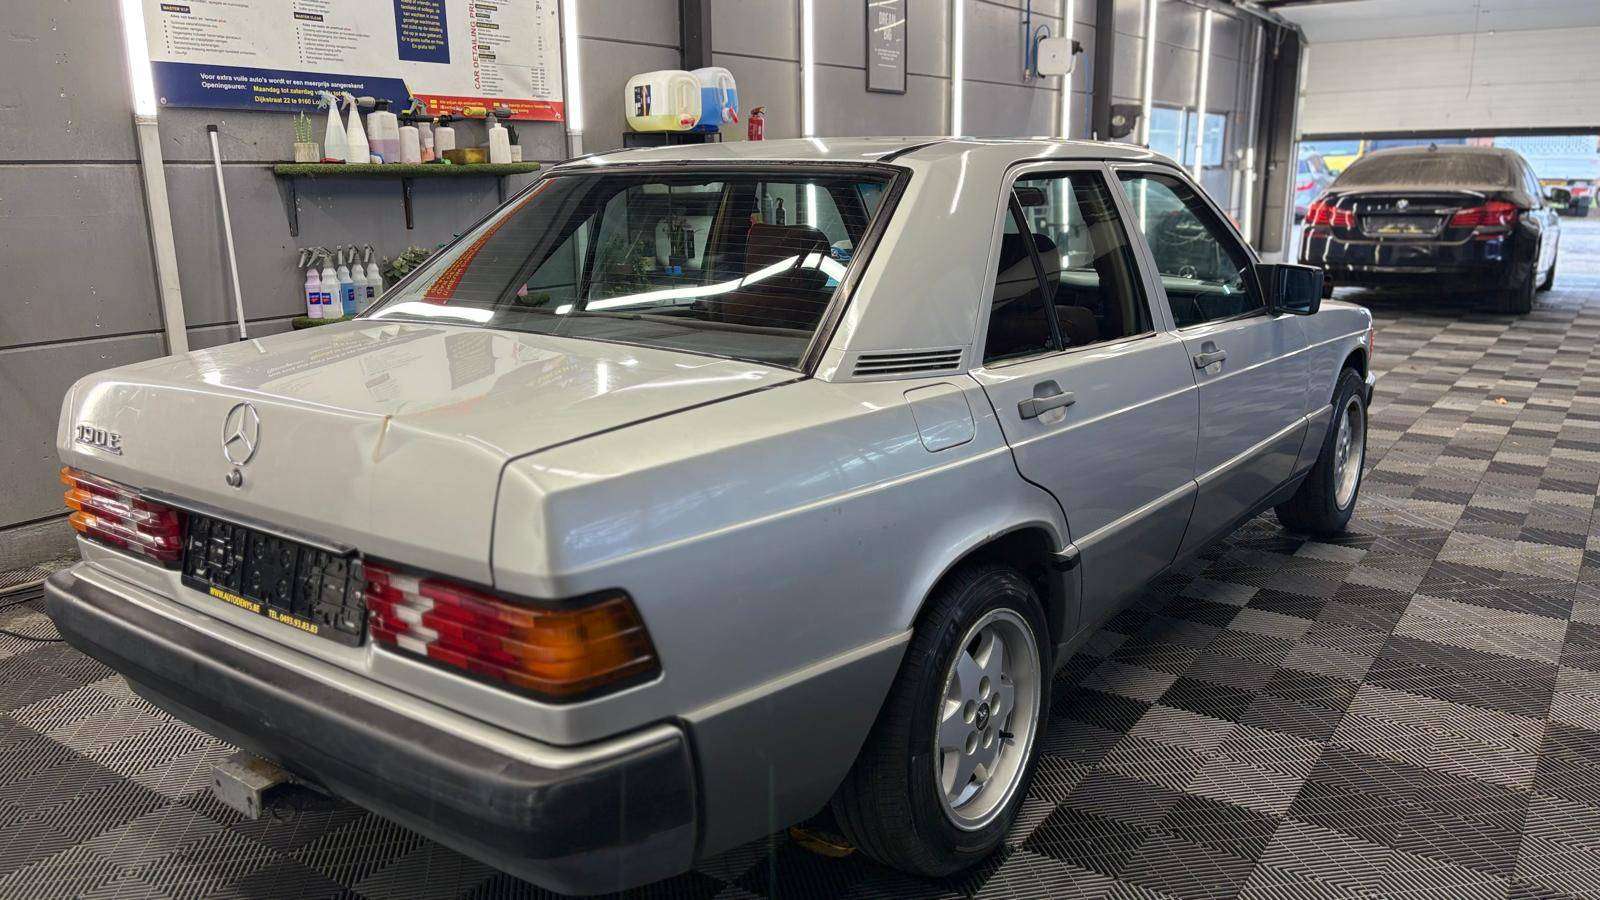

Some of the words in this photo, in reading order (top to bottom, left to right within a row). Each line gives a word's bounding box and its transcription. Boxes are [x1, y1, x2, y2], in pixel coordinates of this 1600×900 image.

[470, 21, 480, 68] DETAILING
[202, 82, 247, 90] Openingsuren:
[253, 86, 280, 94] Maandag
[290, 88, 314, 96] zaterdag
[254, 96, 282, 104] Dijkstraat
[210, 586, 260, 614] WWW.AUTODENYS.BE
